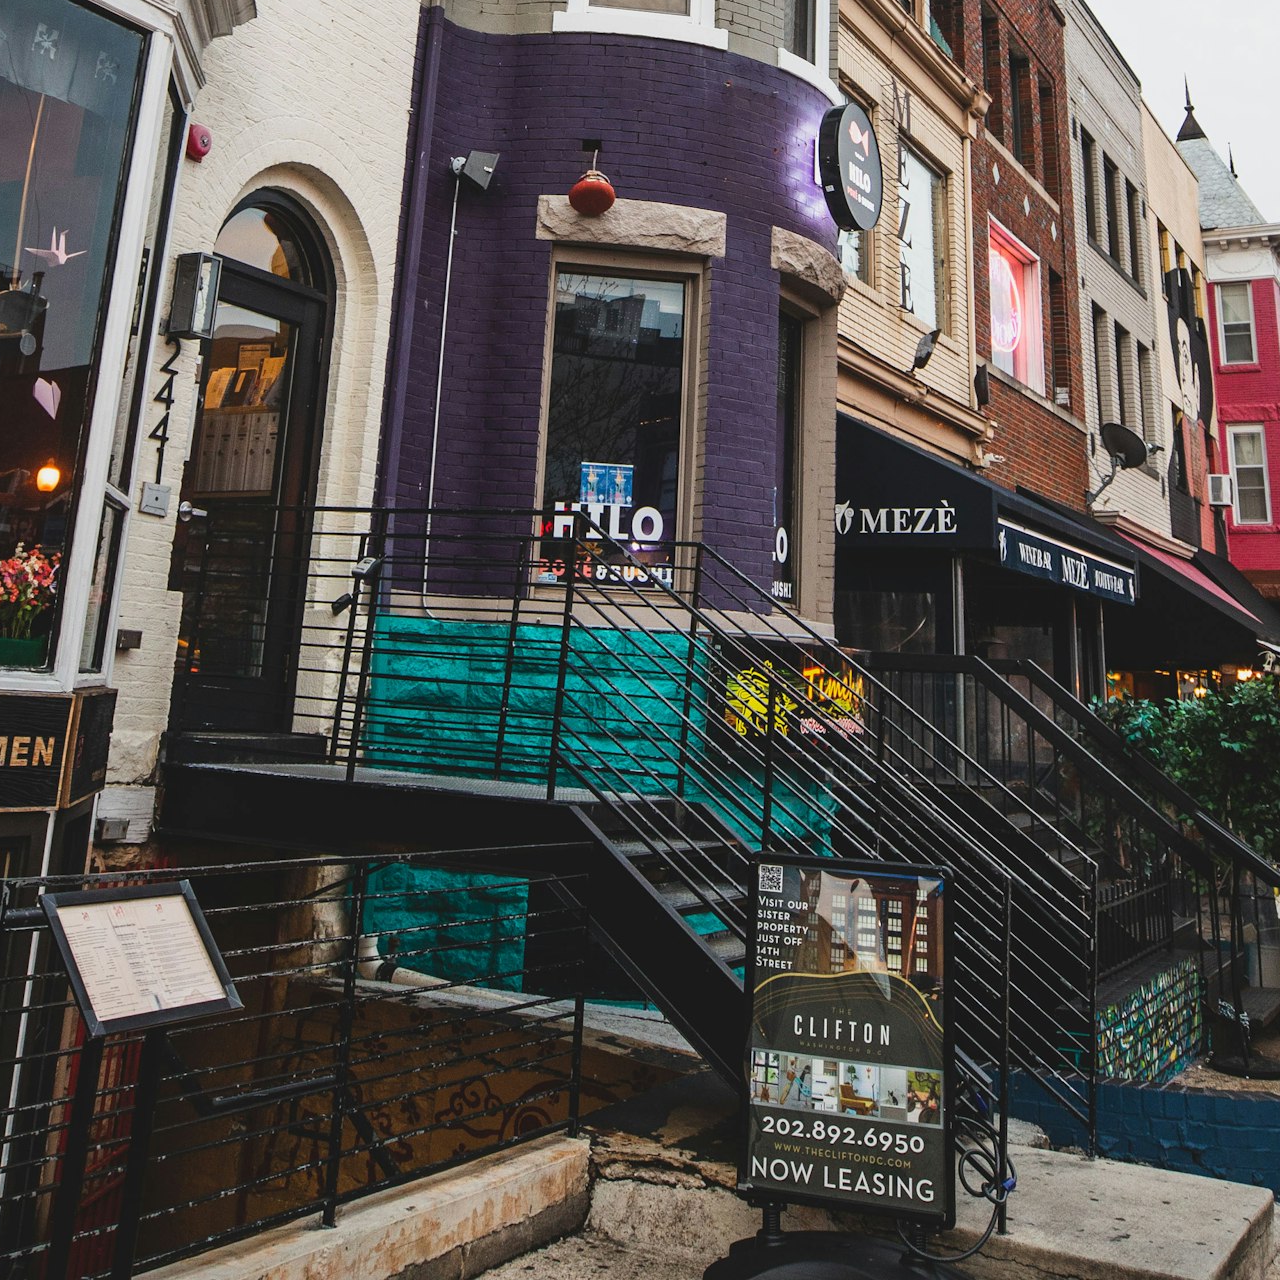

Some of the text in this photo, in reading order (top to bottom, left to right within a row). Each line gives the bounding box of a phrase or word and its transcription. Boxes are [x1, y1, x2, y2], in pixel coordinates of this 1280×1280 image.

[849, 161, 871, 194] HILO
[147, 336, 183, 484] 2441
[553, 502, 664, 541] HILO
[859, 499, 957, 534] MEZÈ
[772, 527, 788, 563] O
[758, 910, 790, 920] SISTER
[787, 901, 808, 910] OUR
[757, 922, 808, 935] PROPERTY
[757, 934, 802, 946] JUST OFF
[756, 946, 779, 956] 14TH
[832, 1007, 852, 1016] THE
[794, 1015, 890, 1046] CLIFTON
[800, 1040, 860, 1053] WASHINGTON
[762, 1116, 925, 1154] 202.892.6950
[774, 1142, 912, 1169] WWW.THECLIFTONDC.COM
[751, 1155, 935, 1202] NOW LEASING
